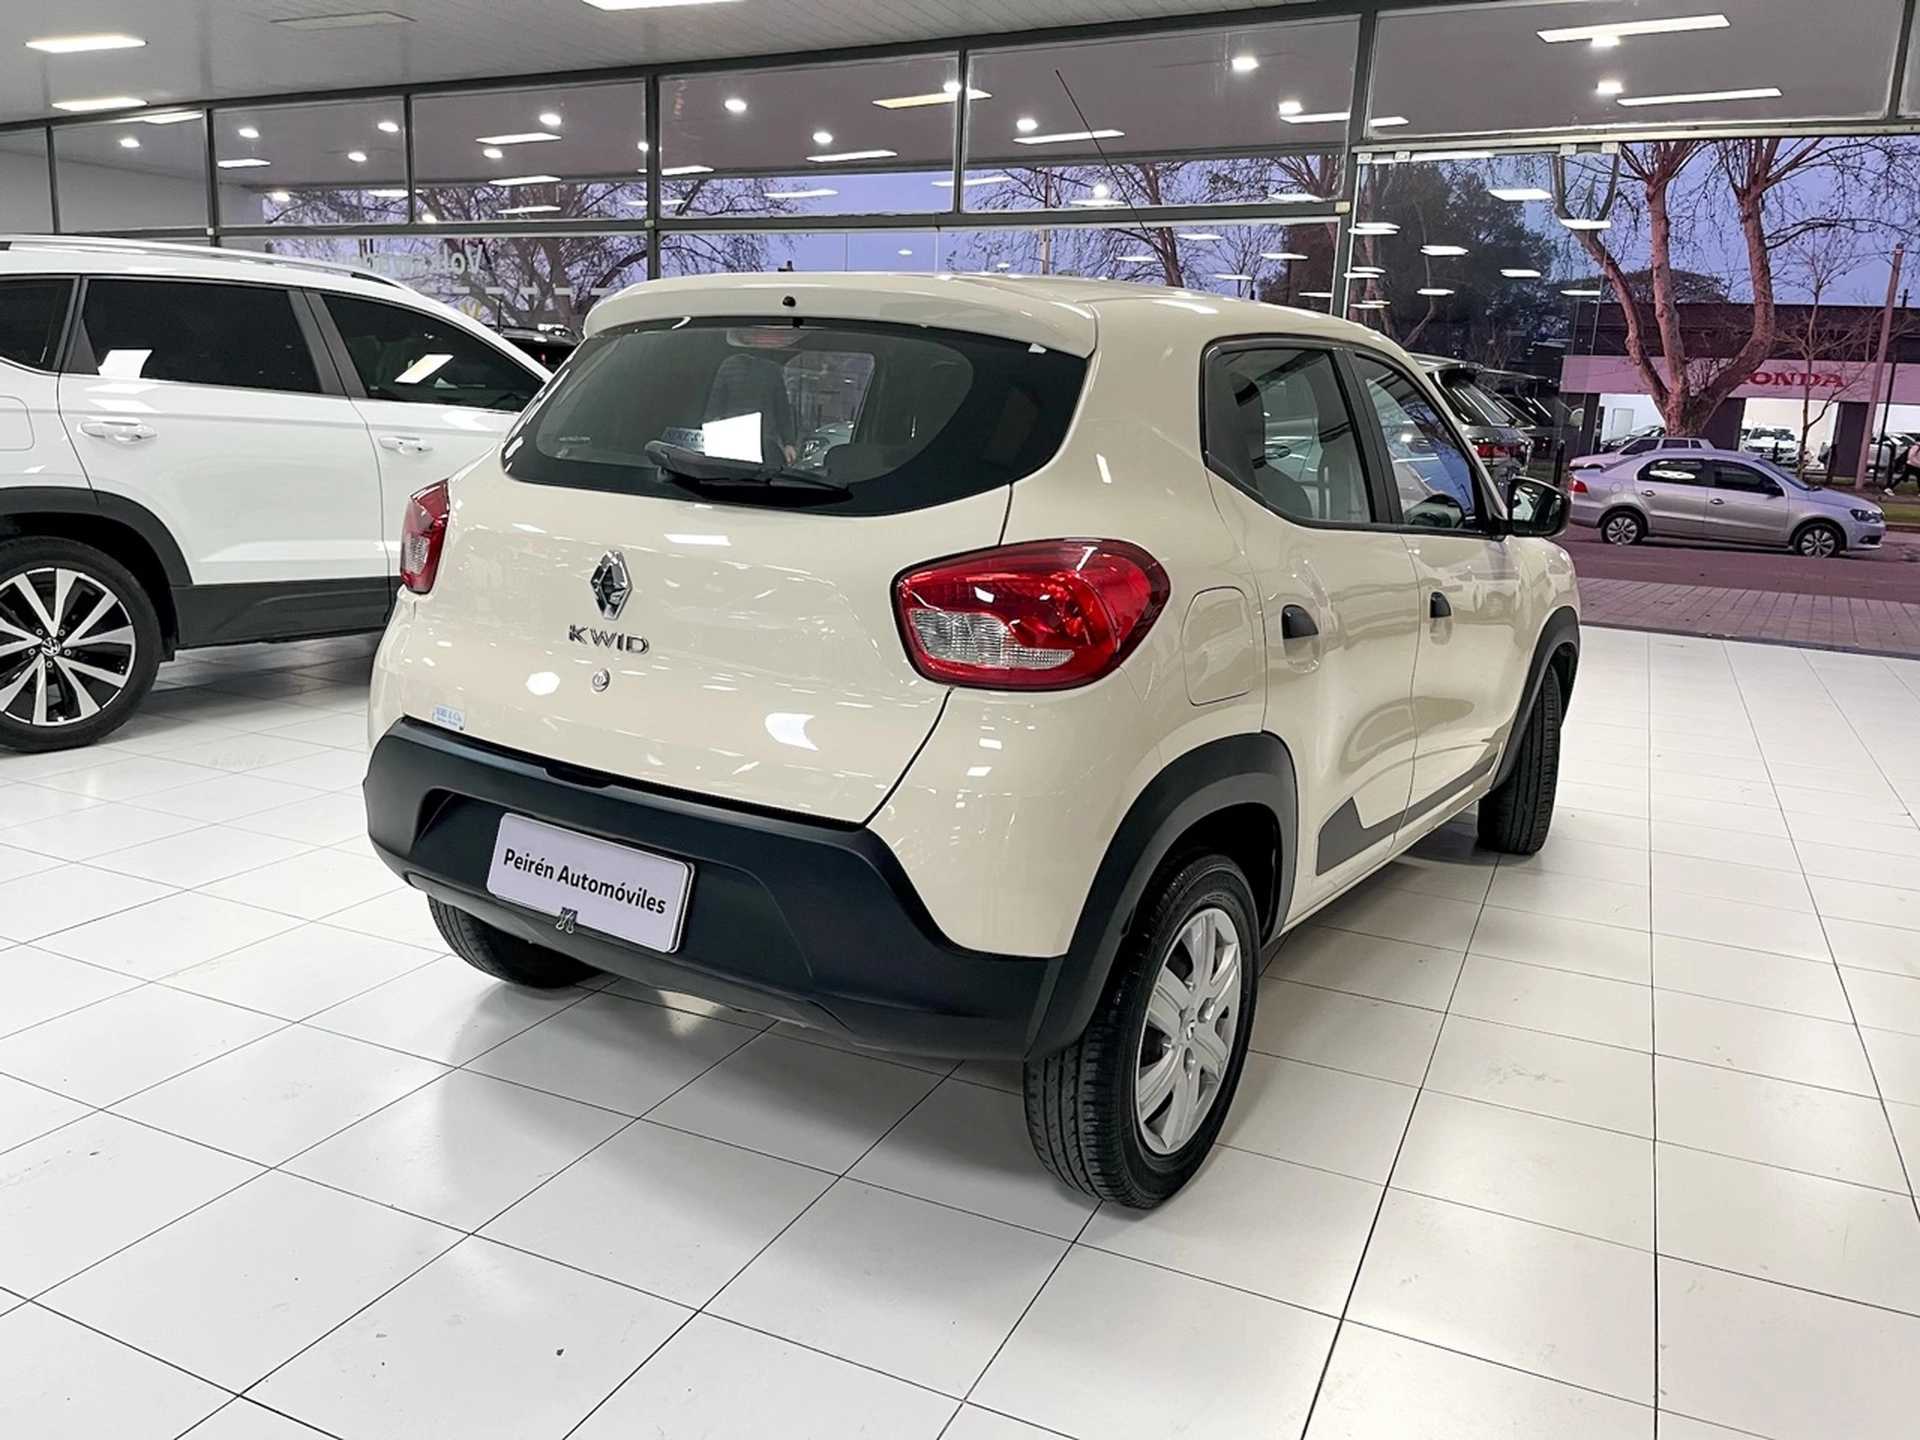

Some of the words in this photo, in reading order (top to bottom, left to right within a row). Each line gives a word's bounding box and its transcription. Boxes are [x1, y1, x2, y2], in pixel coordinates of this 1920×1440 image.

[1747, 371, 1845, 388] ONDA
[568, 624, 650, 655] KWID
[503, 848, 555, 880] Peirén
[557, 865, 667, 915] Automóviles
